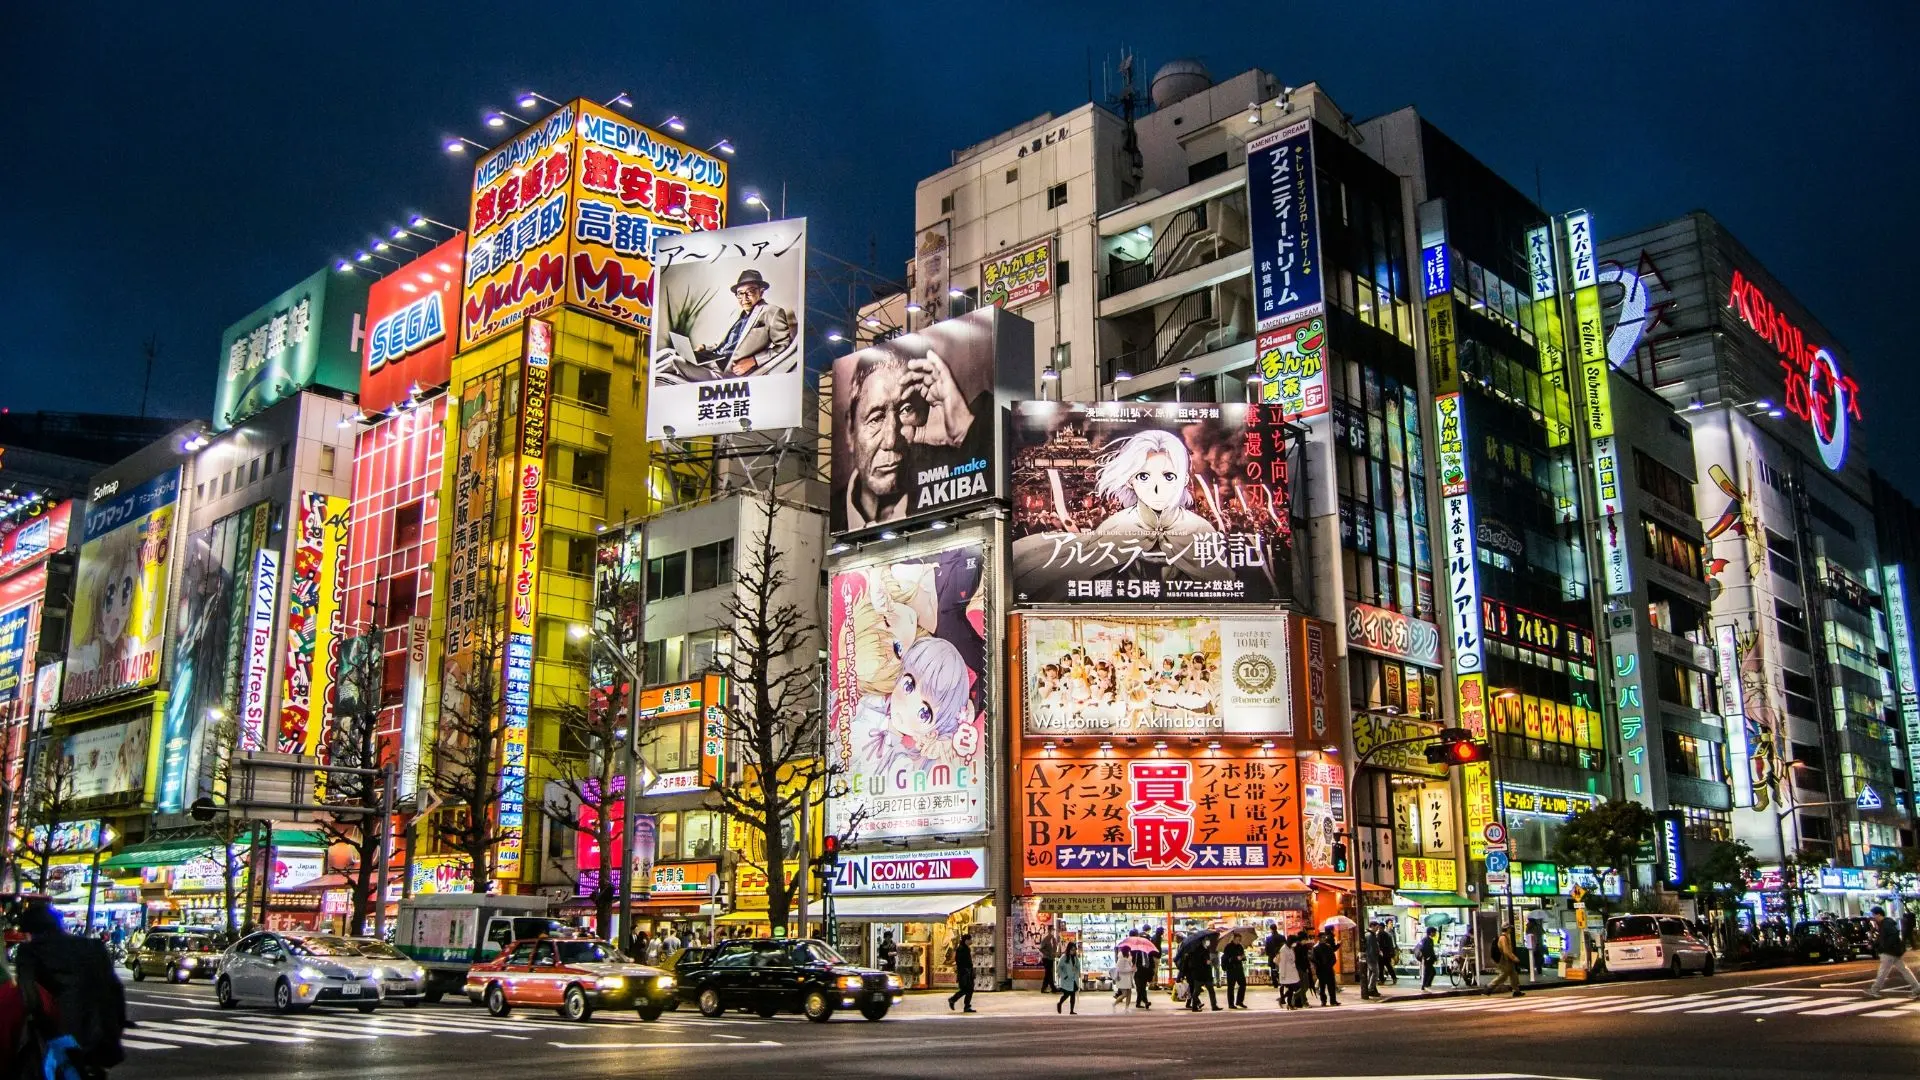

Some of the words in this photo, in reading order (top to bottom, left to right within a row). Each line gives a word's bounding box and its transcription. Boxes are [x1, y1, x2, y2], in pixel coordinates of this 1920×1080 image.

[1250, 133, 1279, 150] AMENITY
[1283, 122, 1307, 139] DREAM
[473, 149, 570, 235] 激安販売
[580, 148, 722, 233] 激安販売
[467, 193, 567, 288] 高額買取
[368, 290, 447, 372] SEGA
[1261, 314, 1291, 331] AMENITY
[1294, 305, 1320, 322] DREAM
[1580, 318, 1595, 359] Yellow
[529, 366, 547, 379] DVD
[1260, 347, 1322, 380] まんが
[529, 397, 543, 407] CD
[697, 400, 751, 421] 英会話
[698, 381, 751, 402] DMM
[1586, 365, 1606, 431] Submarine
[1178, 408, 1220, 419] 田中芳樹
[1439, 396, 1458, 443] まんが
[1596, 438, 1610, 448] 5F
[917, 457, 988, 486] DMM.make
[917, 472, 988, 510] AKIBA
[447, 452, 473, 656] 激安販売の専門店
[1041, 530, 1266, 574] アルスラーン戦記
[1355, 525, 1372, 548] 5F
[258, 552, 276, 610] AKKY
[1165, 579, 1245, 592] TVアニメ放送中
[411, 621, 427, 664] GAME
[1348, 607, 1439, 659] メイドカジノ
[250, 625, 270, 704] Tax-free
[1033, 712, 1111, 730] Welcome
[1115, 715, 1131, 729] to
[1139, 711, 1223, 729] Akihabara
[1615, 653, 1644, 794] リバティー
[1055, 763, 1077, 840] アイドル
[1079, 763, 1101, 820] アニメ
[1101, 762, 1124, 842] 美少女系
[1199, 763, 1220, 842] フィギュア
[1220, 763, 1241, 819] ホビー
[1243, 762, 1267, 842] 携帯電話
[1129, 761, 1195, 870] 買取
[1268, 763, 1293, 867] アップルとか
[1488, 828, 1501, 838] 40
[499, 851, 520, 861] AKIBA
[872, 860, 926, 881] COMIC
[926, 859, 951, 879] ZIN
[1057, 847, 1126, 867] チケット
[1199, 845, 1267, 867] 大黒屋
[1664, 819, 1678, 882] GALLERIA
[834, 855, 868, 890] ZIN
[871, 882, 916, 891] Akihabara
[1111, 895, 1157, 904] WESTERN
[1125, 903, 1157, 911] UNION
